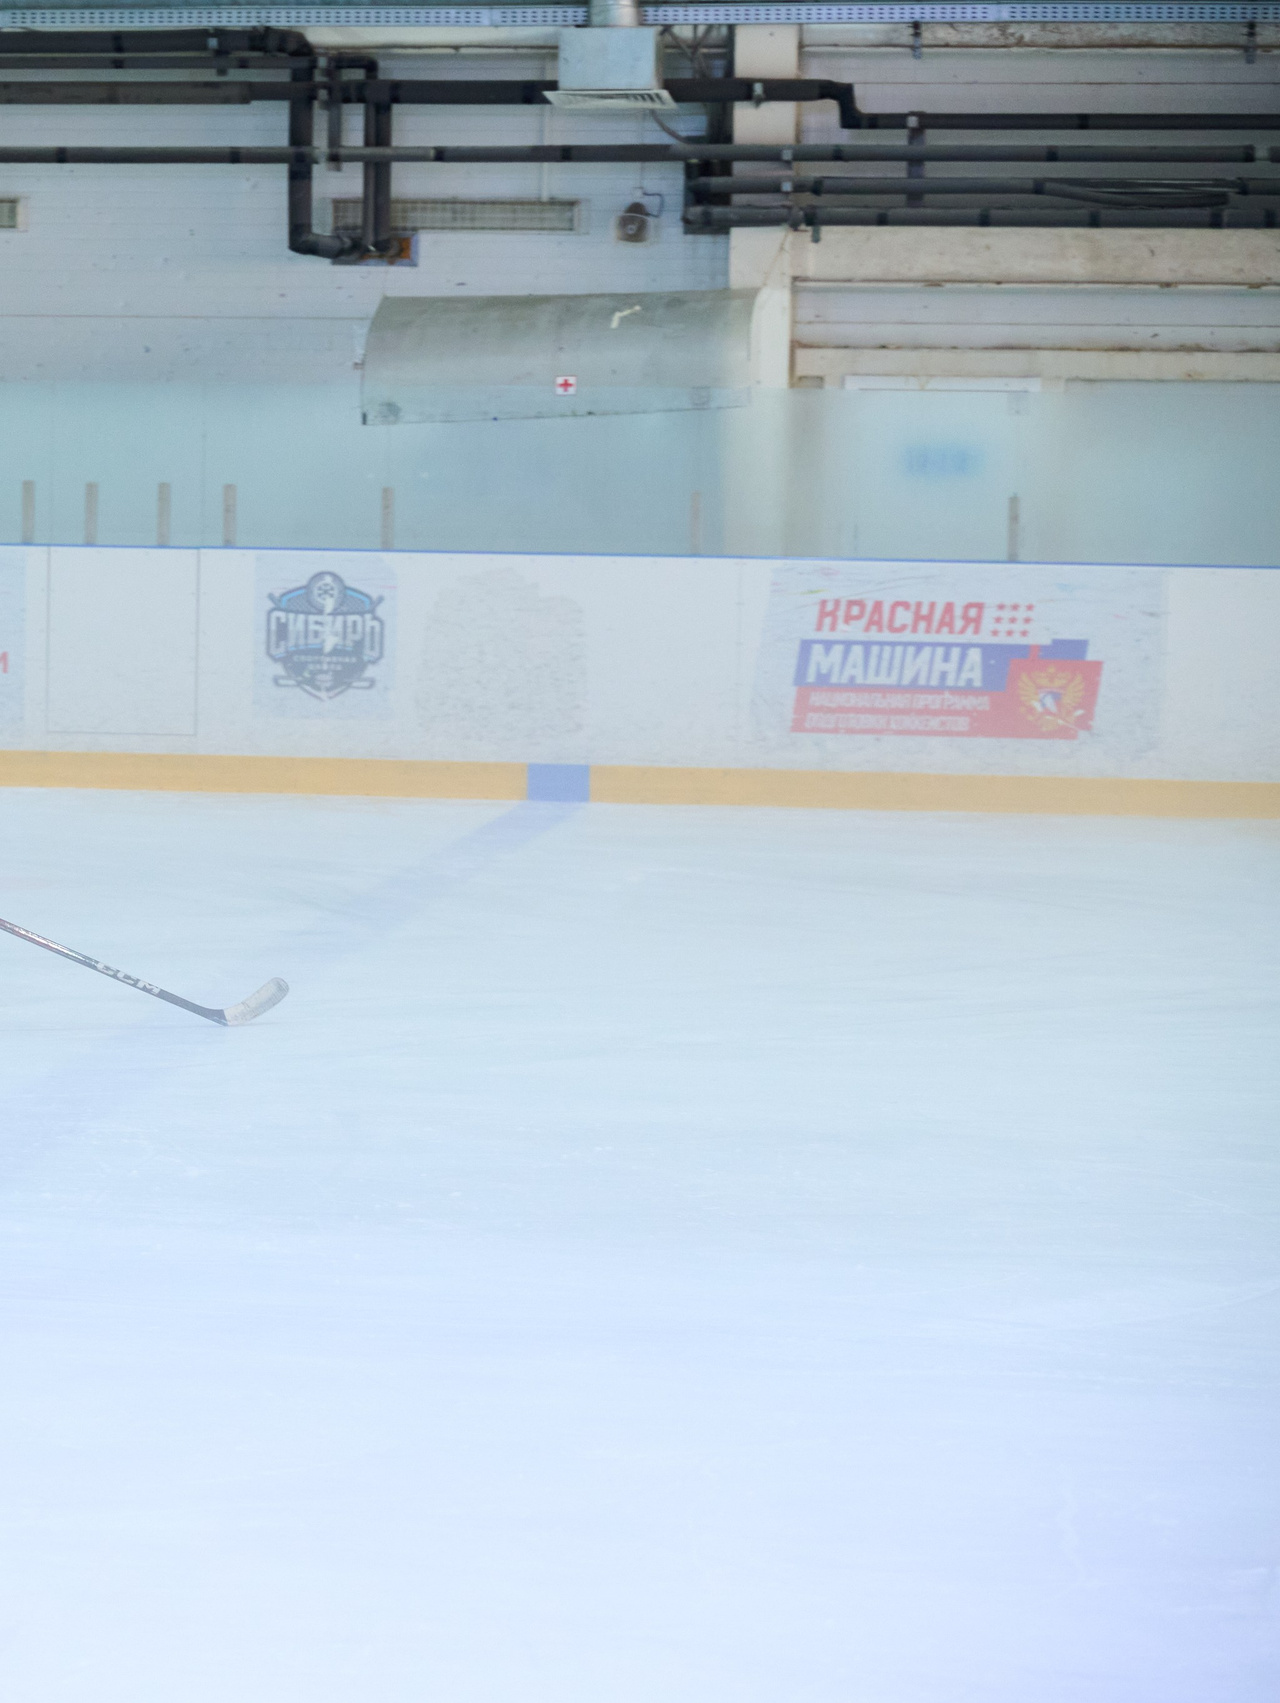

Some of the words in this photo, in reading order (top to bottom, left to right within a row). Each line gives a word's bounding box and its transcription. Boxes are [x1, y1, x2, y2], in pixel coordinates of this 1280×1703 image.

[814, 598, 985, 636] КРАСНАЯ
[805, 643, 984, 688] МАШИНА
[96, 961, 161, 995] CCM
